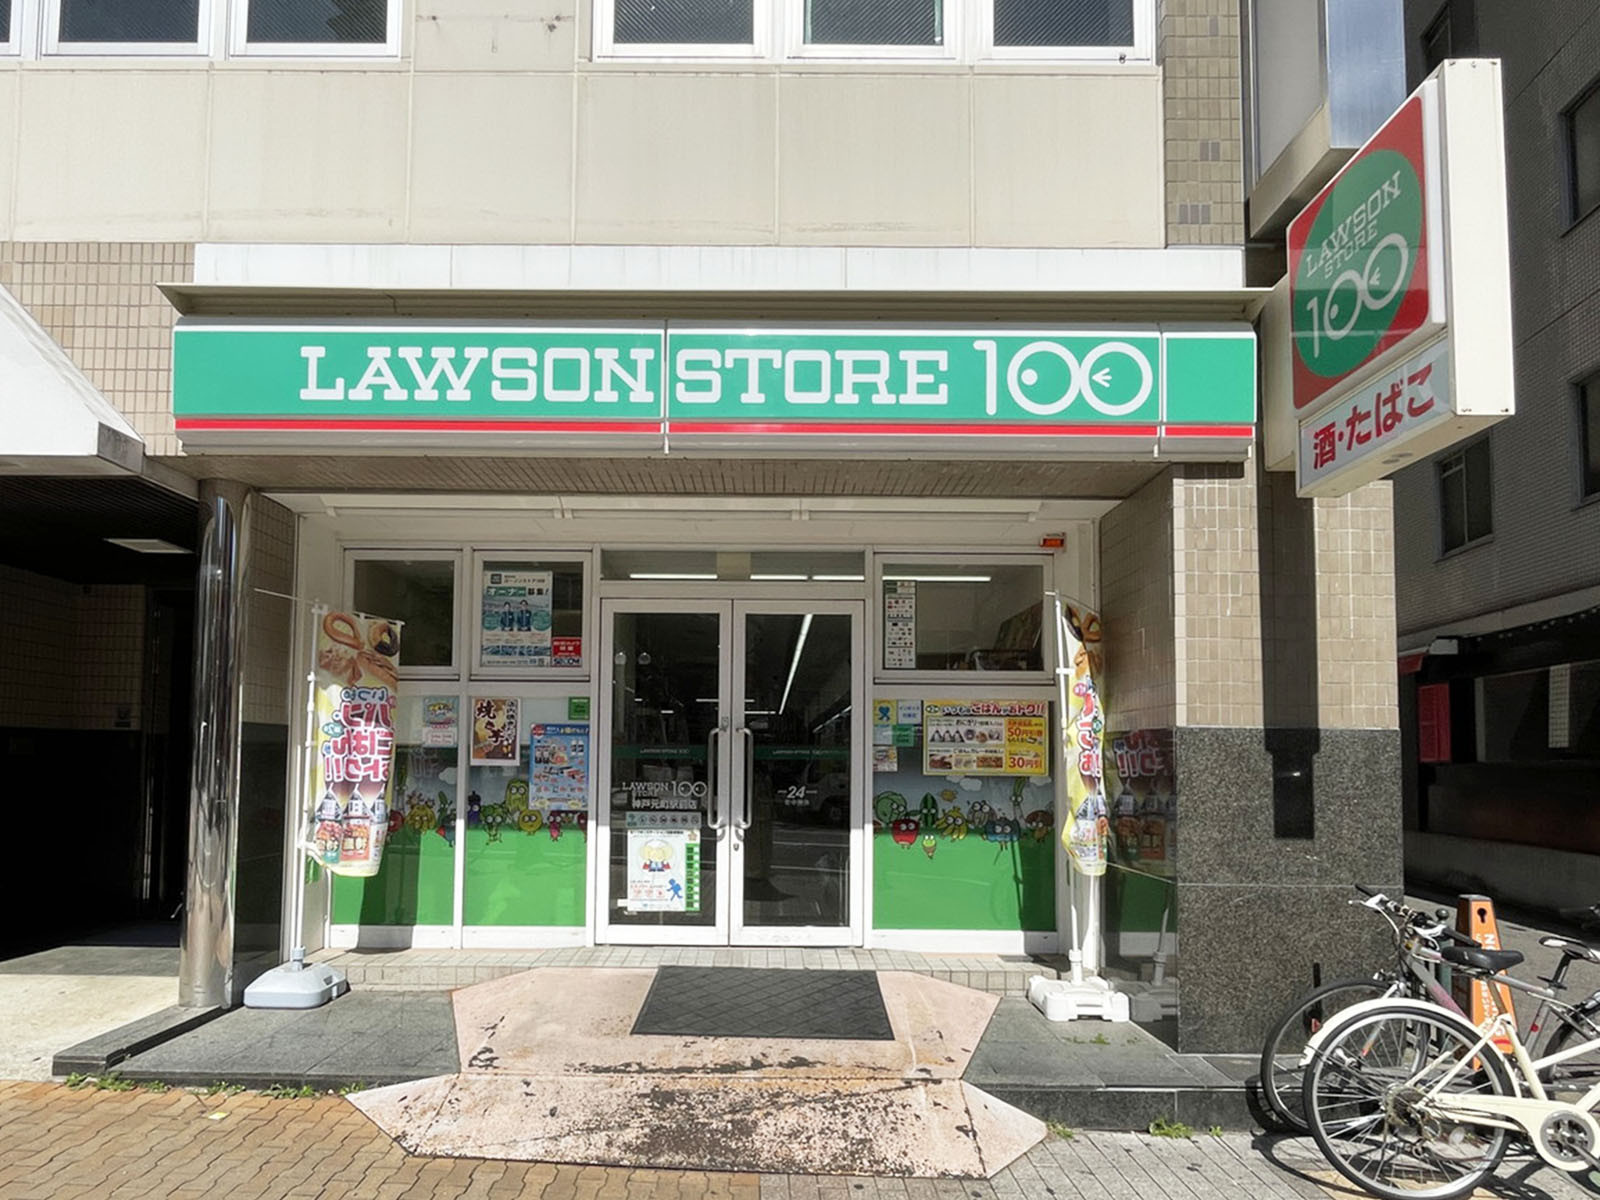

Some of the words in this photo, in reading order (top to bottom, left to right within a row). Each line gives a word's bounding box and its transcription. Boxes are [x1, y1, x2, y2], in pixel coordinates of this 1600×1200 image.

[1306, 170, 1402, 278] LAWSON
[1324, 220, 1379, 280] STORE
[1306, 232, 1409, 359] 100
[299, 346, 654, 403] LAWSON
[675, 348, 949, 405] STORE
[972, 340, 1154, 416] 100
[1312, 364, 1436, 470] 酒・たばこ
[622, 781, 669, 792] LAWSON
[672, 781, 707, 797] 100
[787, 786, 806, 799] 24
